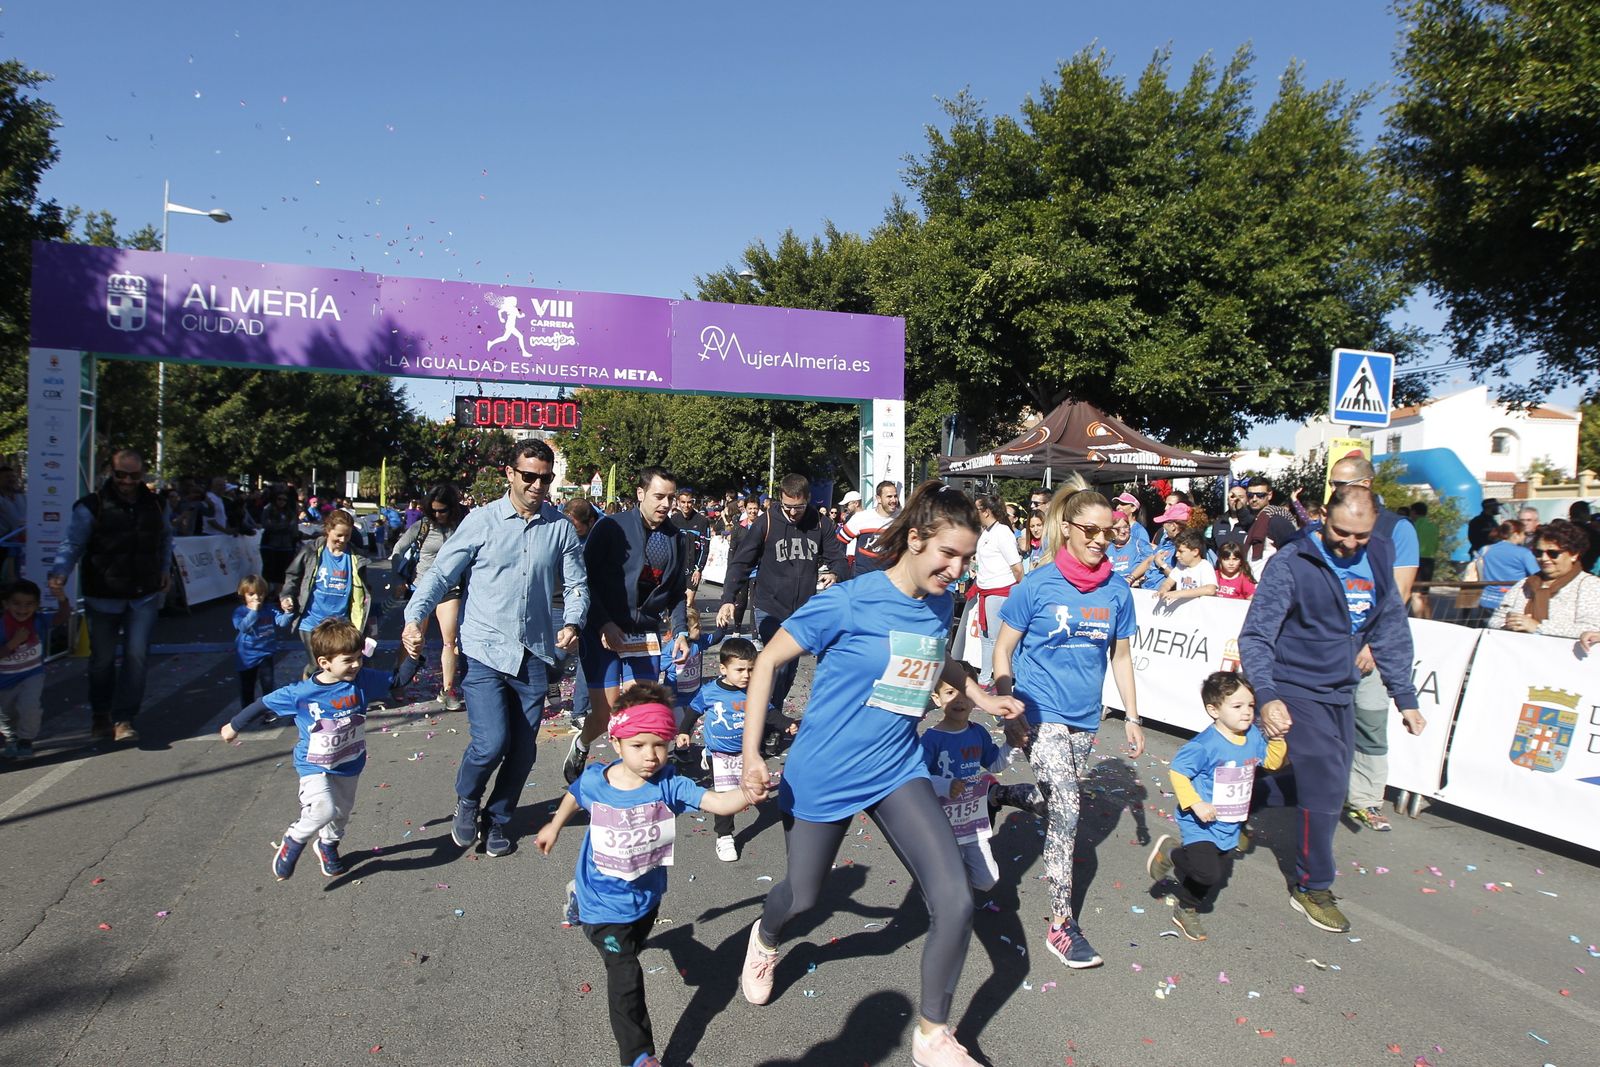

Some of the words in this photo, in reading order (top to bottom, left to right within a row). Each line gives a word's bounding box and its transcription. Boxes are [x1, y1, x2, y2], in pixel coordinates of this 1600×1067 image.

[182, 283, 341, 321] ALMERÍA
[531, 298, 573, 318] VIII
[182, 314, 263, 336] CIUDAD
[530, 319, 575, 329] CARRERA
[389, 354, 410, 368] LA
[415, 356, 504, 374] IGUALDAD
[510, 361, 530, 375] ES
[535, 364, 609, 379] NUESTRA
[613, 367, 663, 382] META.
[775, 537, 819, 563] GAP
[1081, 607, 1111, 621] VIII
[1132, 624, 1209, 663] MERÍA
[321, 728, 356, 748] 3041
[945, 800, 979, 818] 3155
[604, 825, 661, 849] 3229
